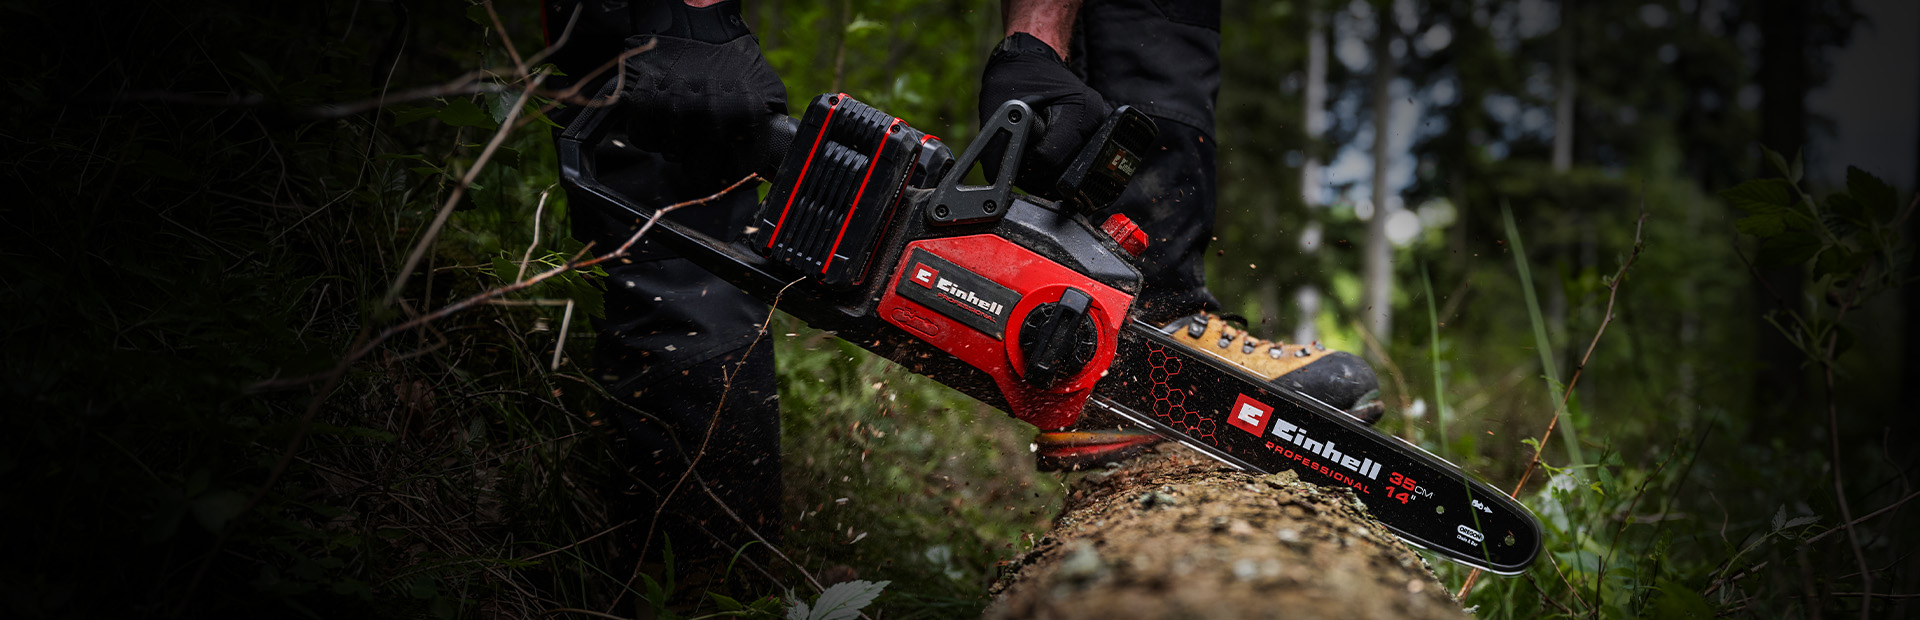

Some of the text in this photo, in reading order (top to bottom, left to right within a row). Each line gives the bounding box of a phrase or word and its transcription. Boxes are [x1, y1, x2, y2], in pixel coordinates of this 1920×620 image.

[937, 277, 1004, 316] Einhell
[937, 291, 997, 323] PROFESSIONAL
[1265, 440, 1370, 495] PROFESSIONAL
[1271, 418, 1382, 481] Einhell
[1459, 526, 1483, 541] OREGON
